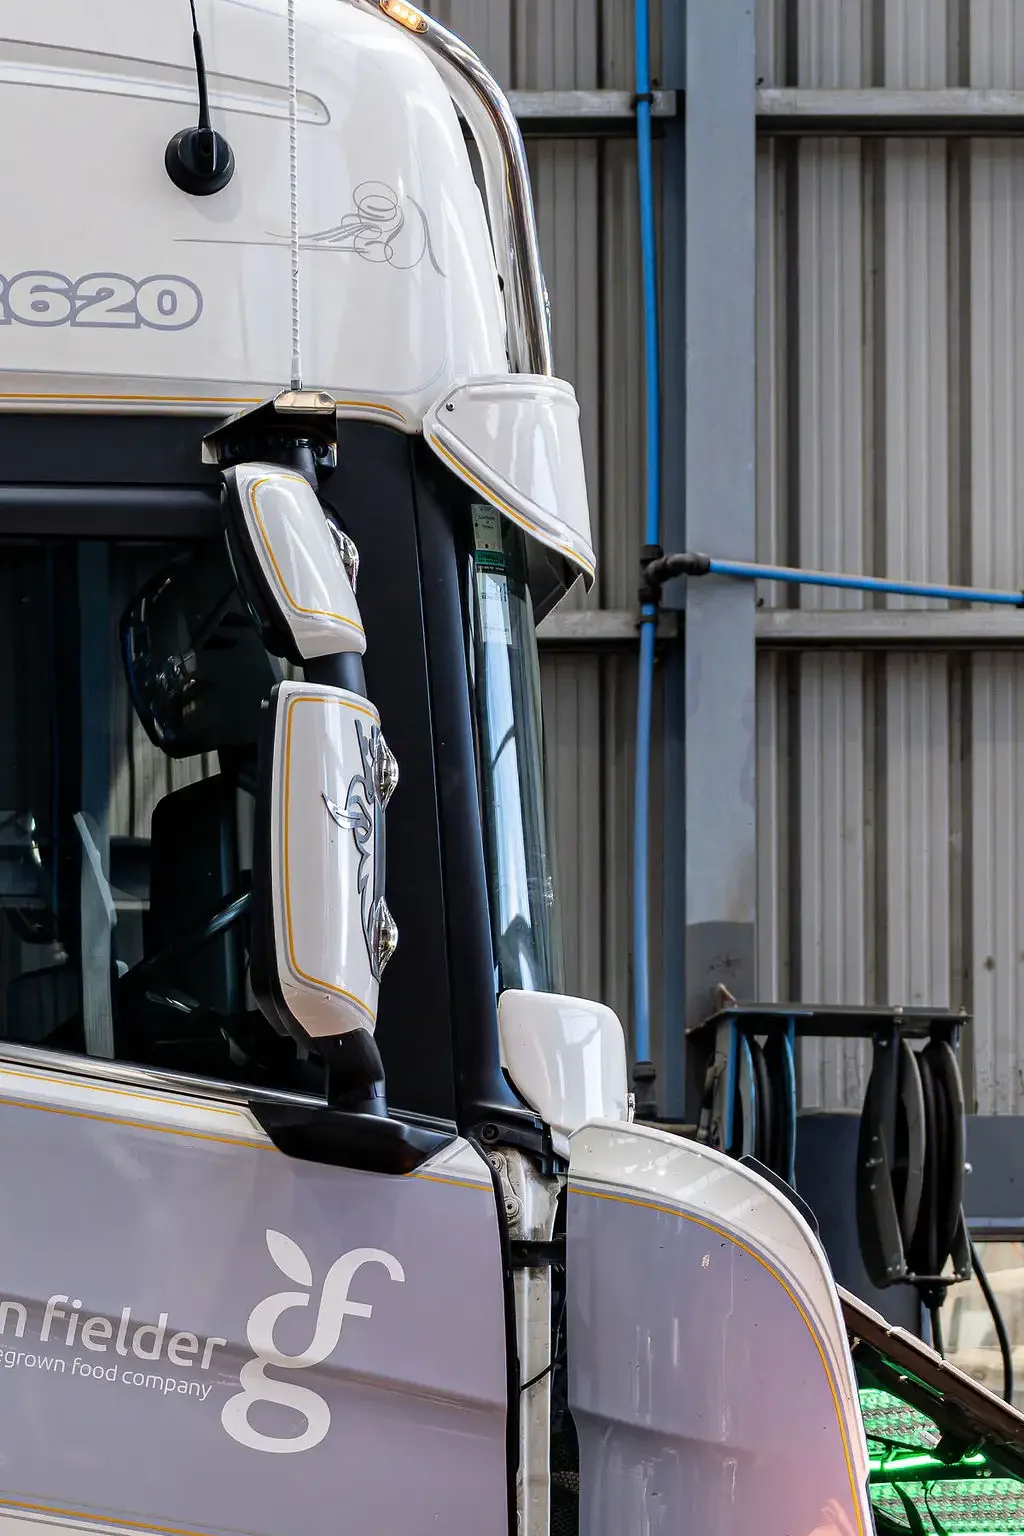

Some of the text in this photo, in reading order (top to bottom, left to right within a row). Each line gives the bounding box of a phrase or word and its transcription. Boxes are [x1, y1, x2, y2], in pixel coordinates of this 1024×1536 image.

[0, 270, 204, 332] 620
[39, 1294, 228, 1370] fielder
[71, 1357, 119, 1382] food
[121, 1370, 213, 1402] company
